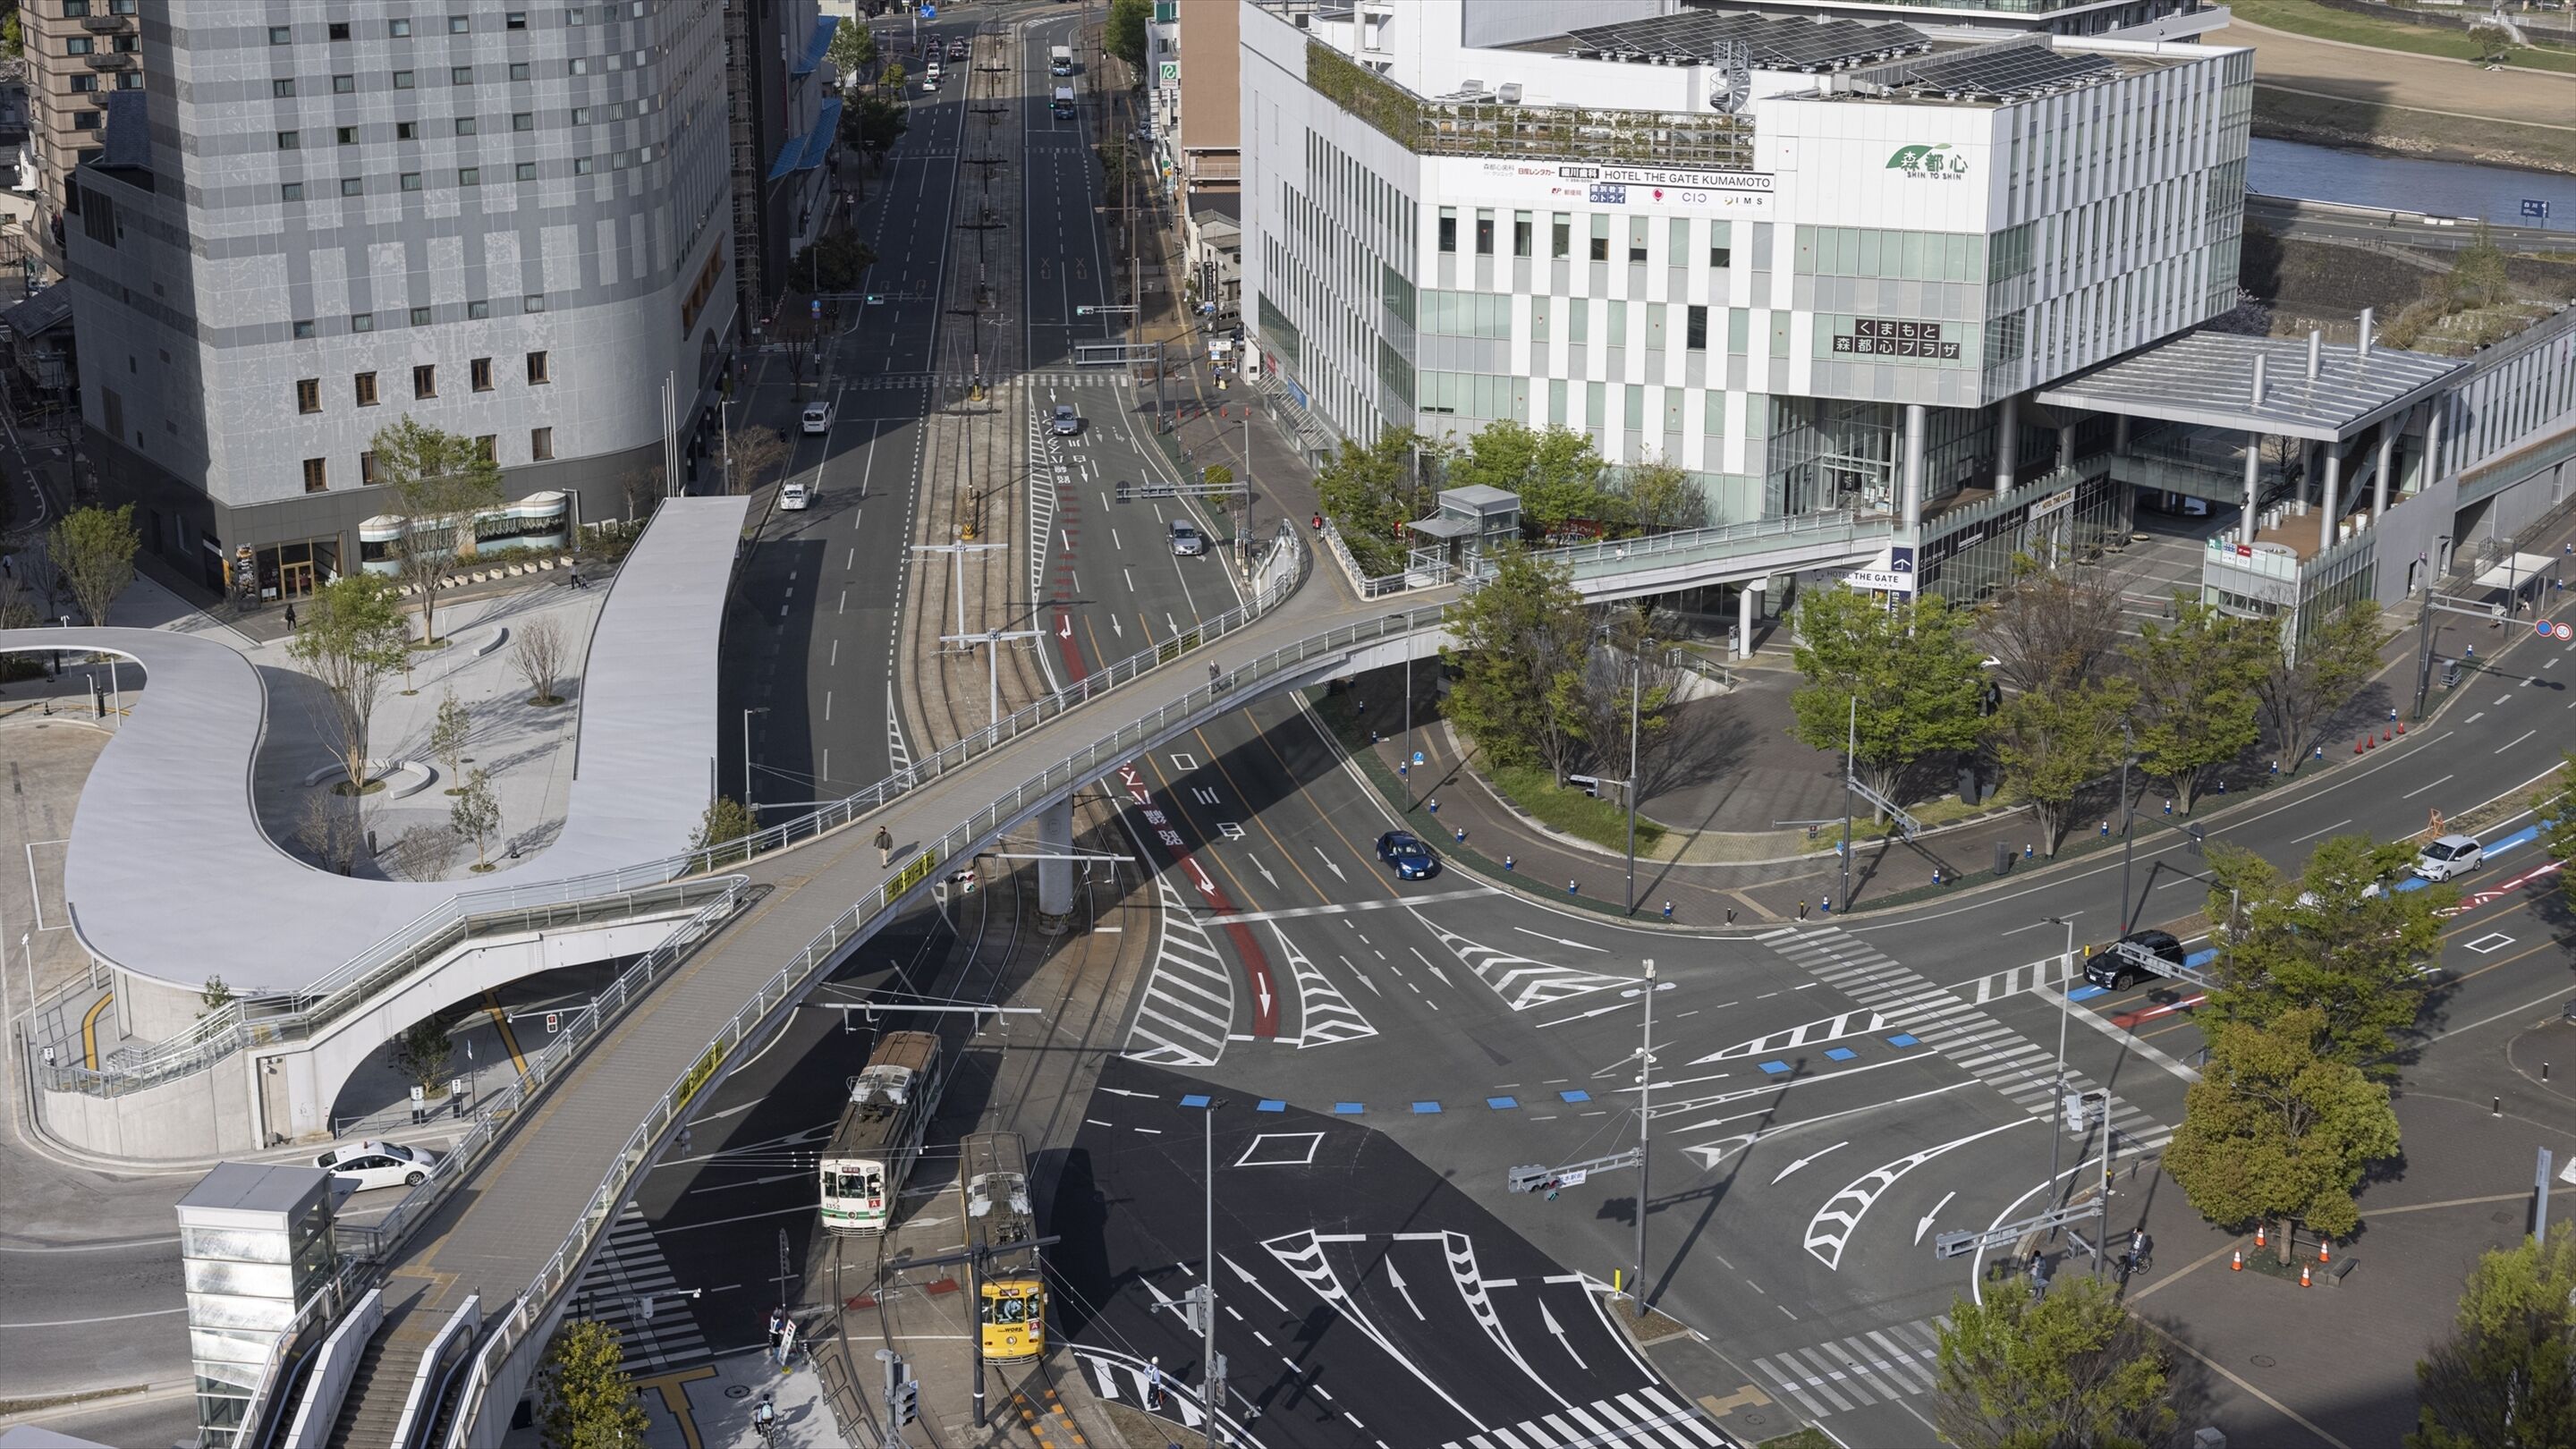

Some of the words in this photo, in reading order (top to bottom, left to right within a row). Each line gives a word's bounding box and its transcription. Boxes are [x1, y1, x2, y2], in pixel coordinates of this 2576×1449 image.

[1901, 150, 1969, 174] 森都心
[1518, 167, 1555, 176] 日産レンタカー
[1907, 171, 1926, 179] SHIN
[1605, 170, 1640, 182] HOTEL
[1644, 172, 1665, 182] THE
[1669, 172, 1699, 184] GATE
[1702, 174, 1771, 188] KUMAMOTO
[1589, 184, 1626, 194] 個別教室
[1589, 193, 1625, 203] のトライ
[1860, 321, 1936, 339] くまもと
[1835, 336, 1958, 358] 森都心プラザ
[1826, 571, 1852, 579] HOTEL
[1854, 572, 1872, 581] THE
[1874, 573, 1899, 583] GATE
